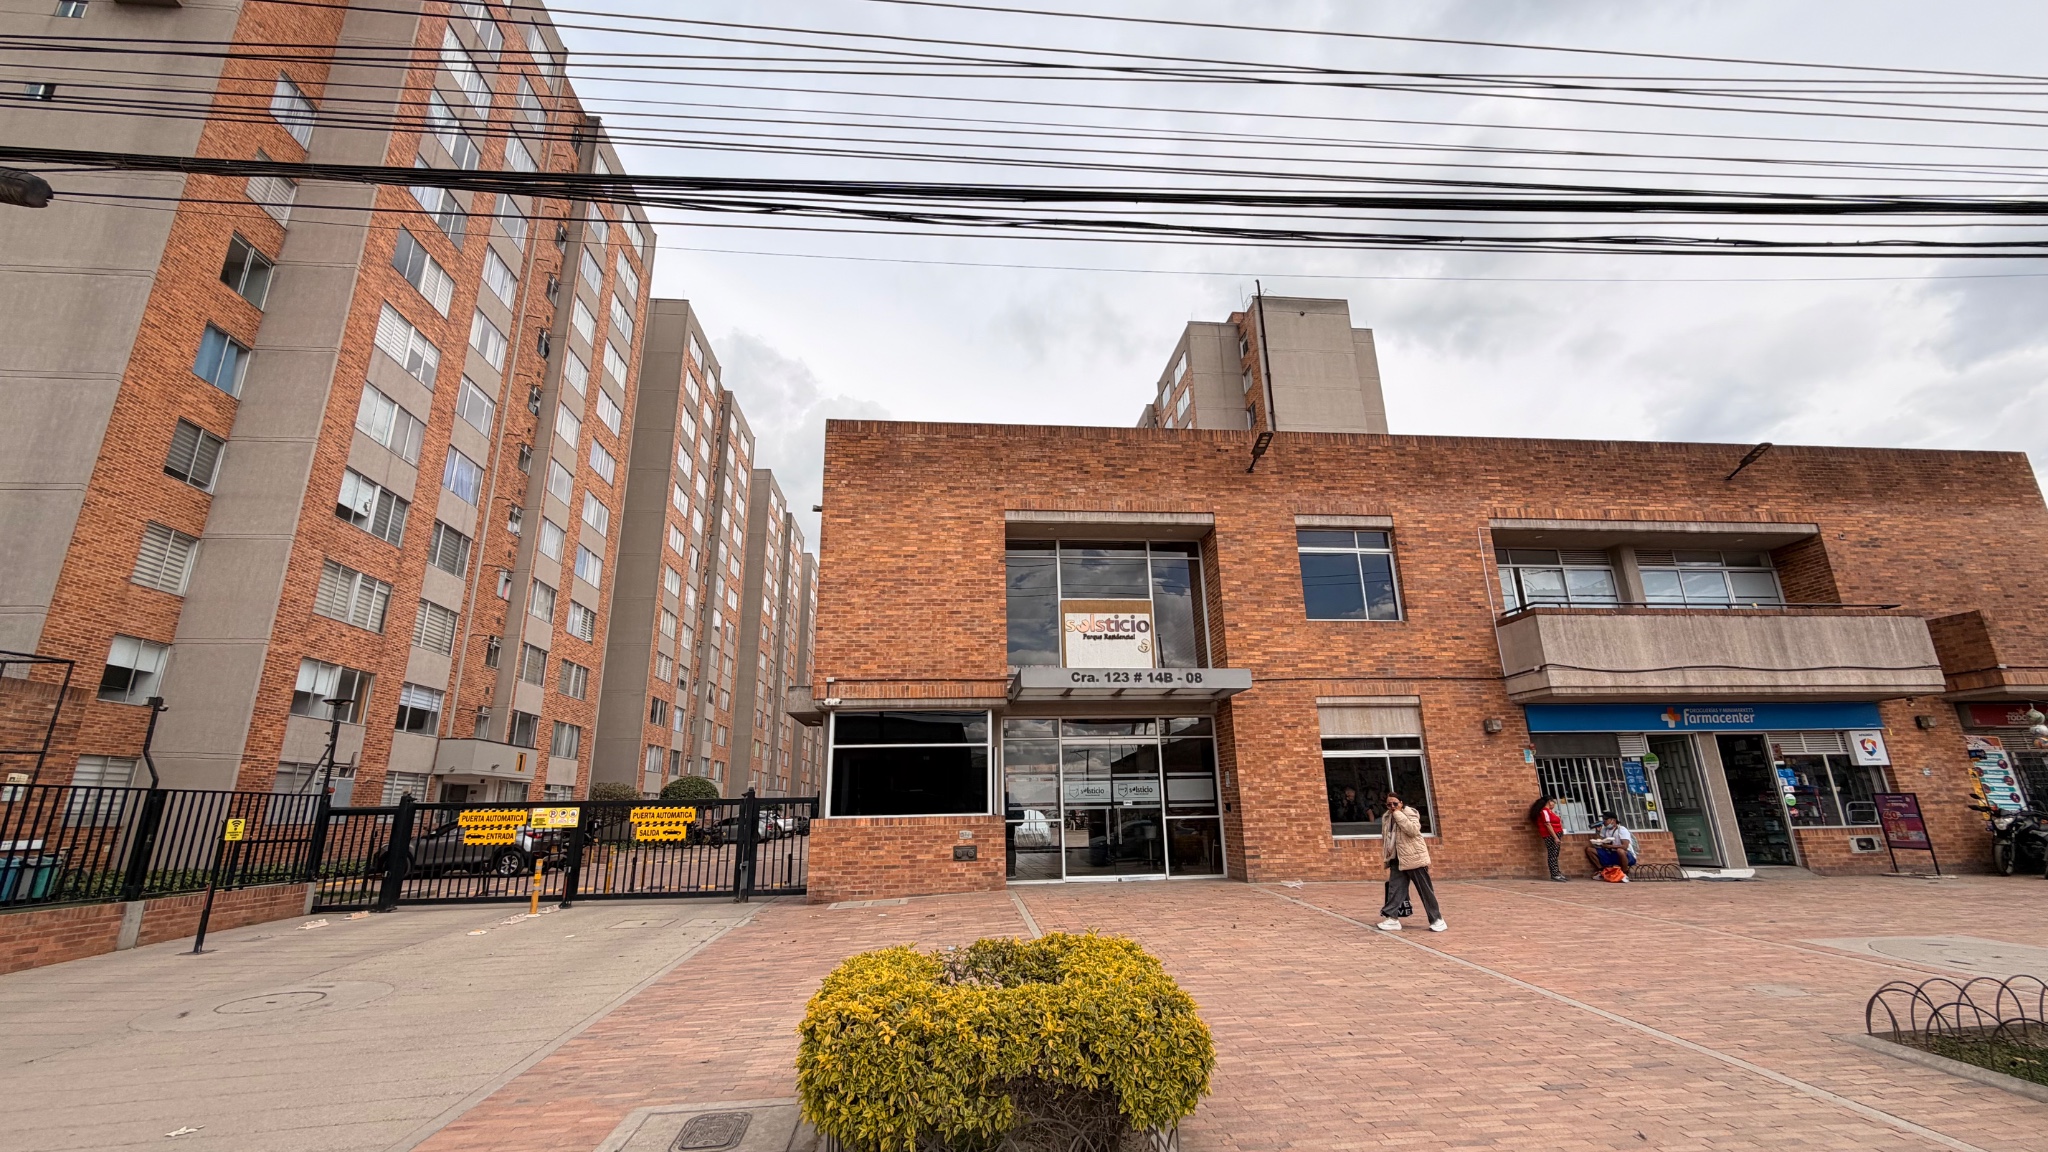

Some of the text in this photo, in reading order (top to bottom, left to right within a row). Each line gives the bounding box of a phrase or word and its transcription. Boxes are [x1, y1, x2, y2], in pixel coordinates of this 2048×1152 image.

[1065, 614, 1150, 633] solsticio
[1071, 672, 1099, 683] Cra.
[1105, 672, 1130, 683] 123
[1134, 672, 1142, 683] #
[1147, 672, 1173, 683] 14B
[1186, 672, 1203, 683] 08
[1684, 709, 1755, 726] farmacenter
[486, 814, 524, 822] AUTOMATICA
[486, 832, 514, 840] ENTRADA
